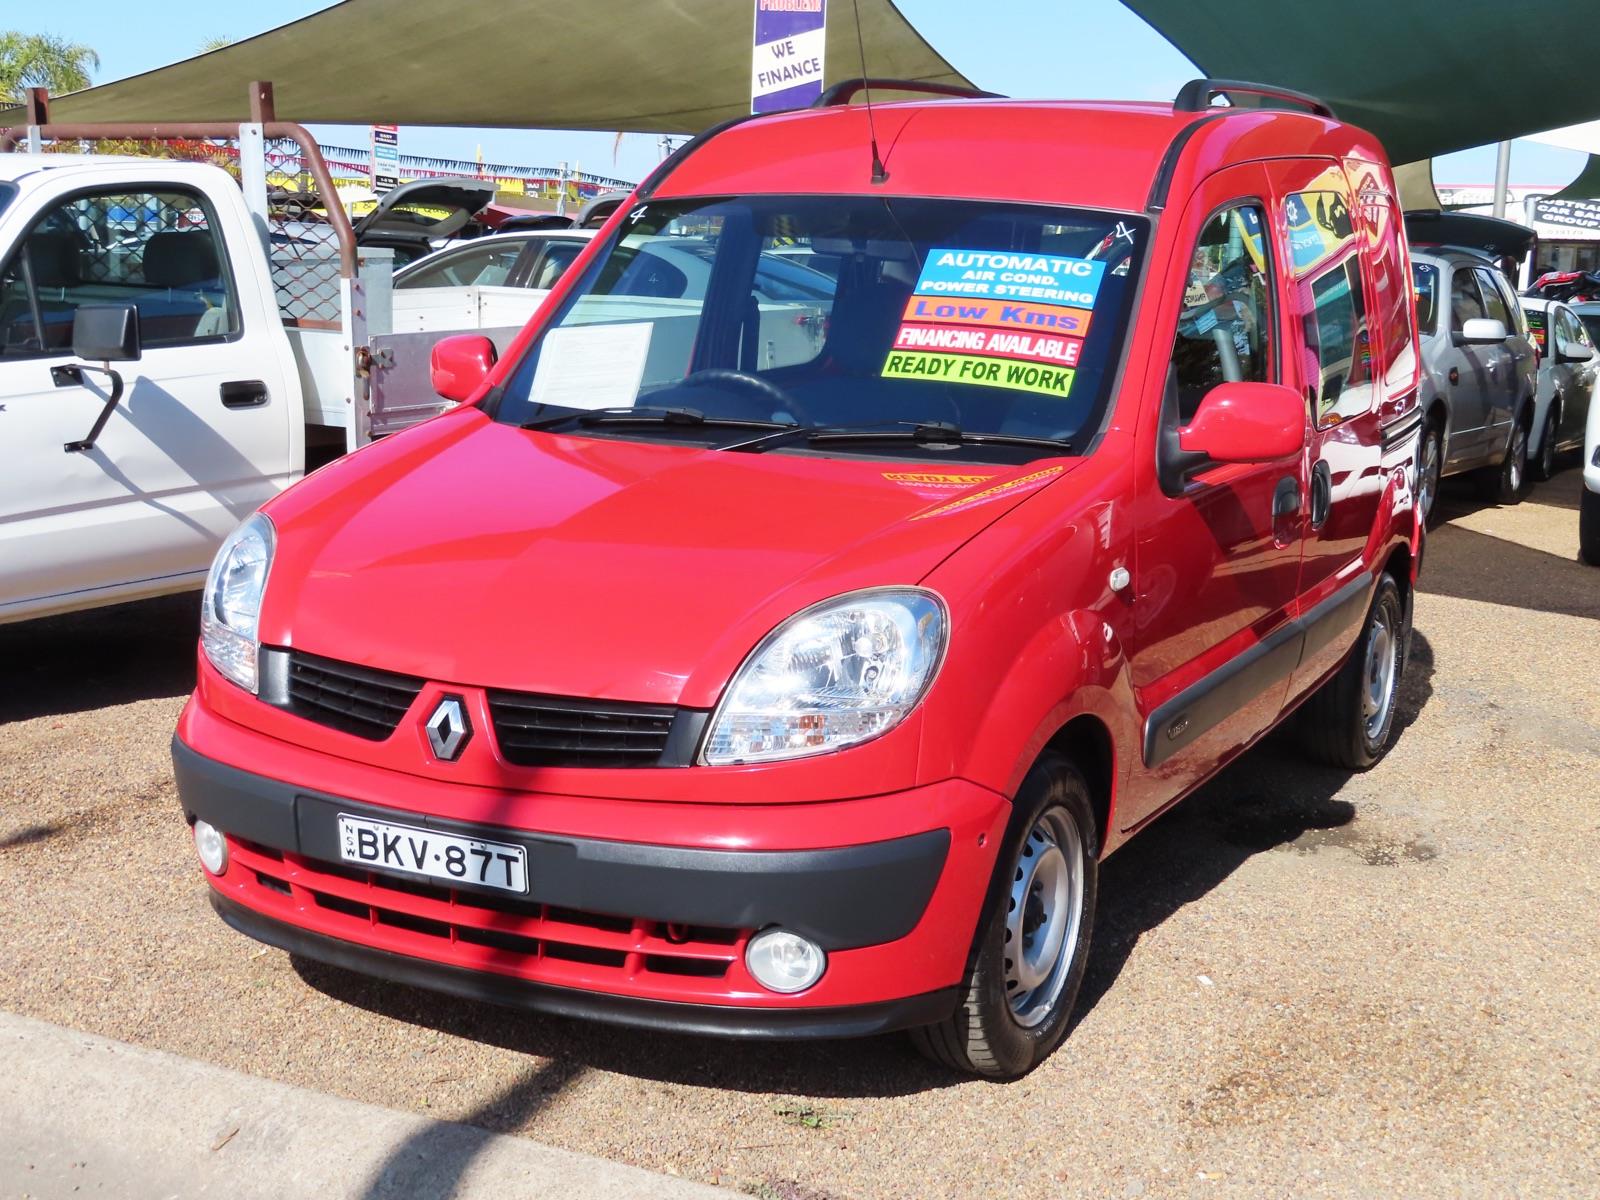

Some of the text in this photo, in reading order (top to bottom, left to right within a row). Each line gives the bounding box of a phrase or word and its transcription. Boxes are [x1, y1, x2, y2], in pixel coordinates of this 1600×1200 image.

[771, 41, 795, 59] WE
[758, 57, 821, 88] FINANCE
[630, 205, 648, 225] 4
[1537, 204, 1570, 216] CAR
[1542, 213, 1598, 227] GROUP
[1116, 221, 1136, 245] 4
[936, 252, 1093, 277] AUTOMATIC
[961, 270, 1059, 286] AIR COND.
[920, 281, 1094, 304] POWER STEERING
[914, 301, 1079, 330] Low Kms
[897, 328, 1079, 362] FINANCING AVAILABLE
[887, 355, 1070, 391] READY FOR WORK
